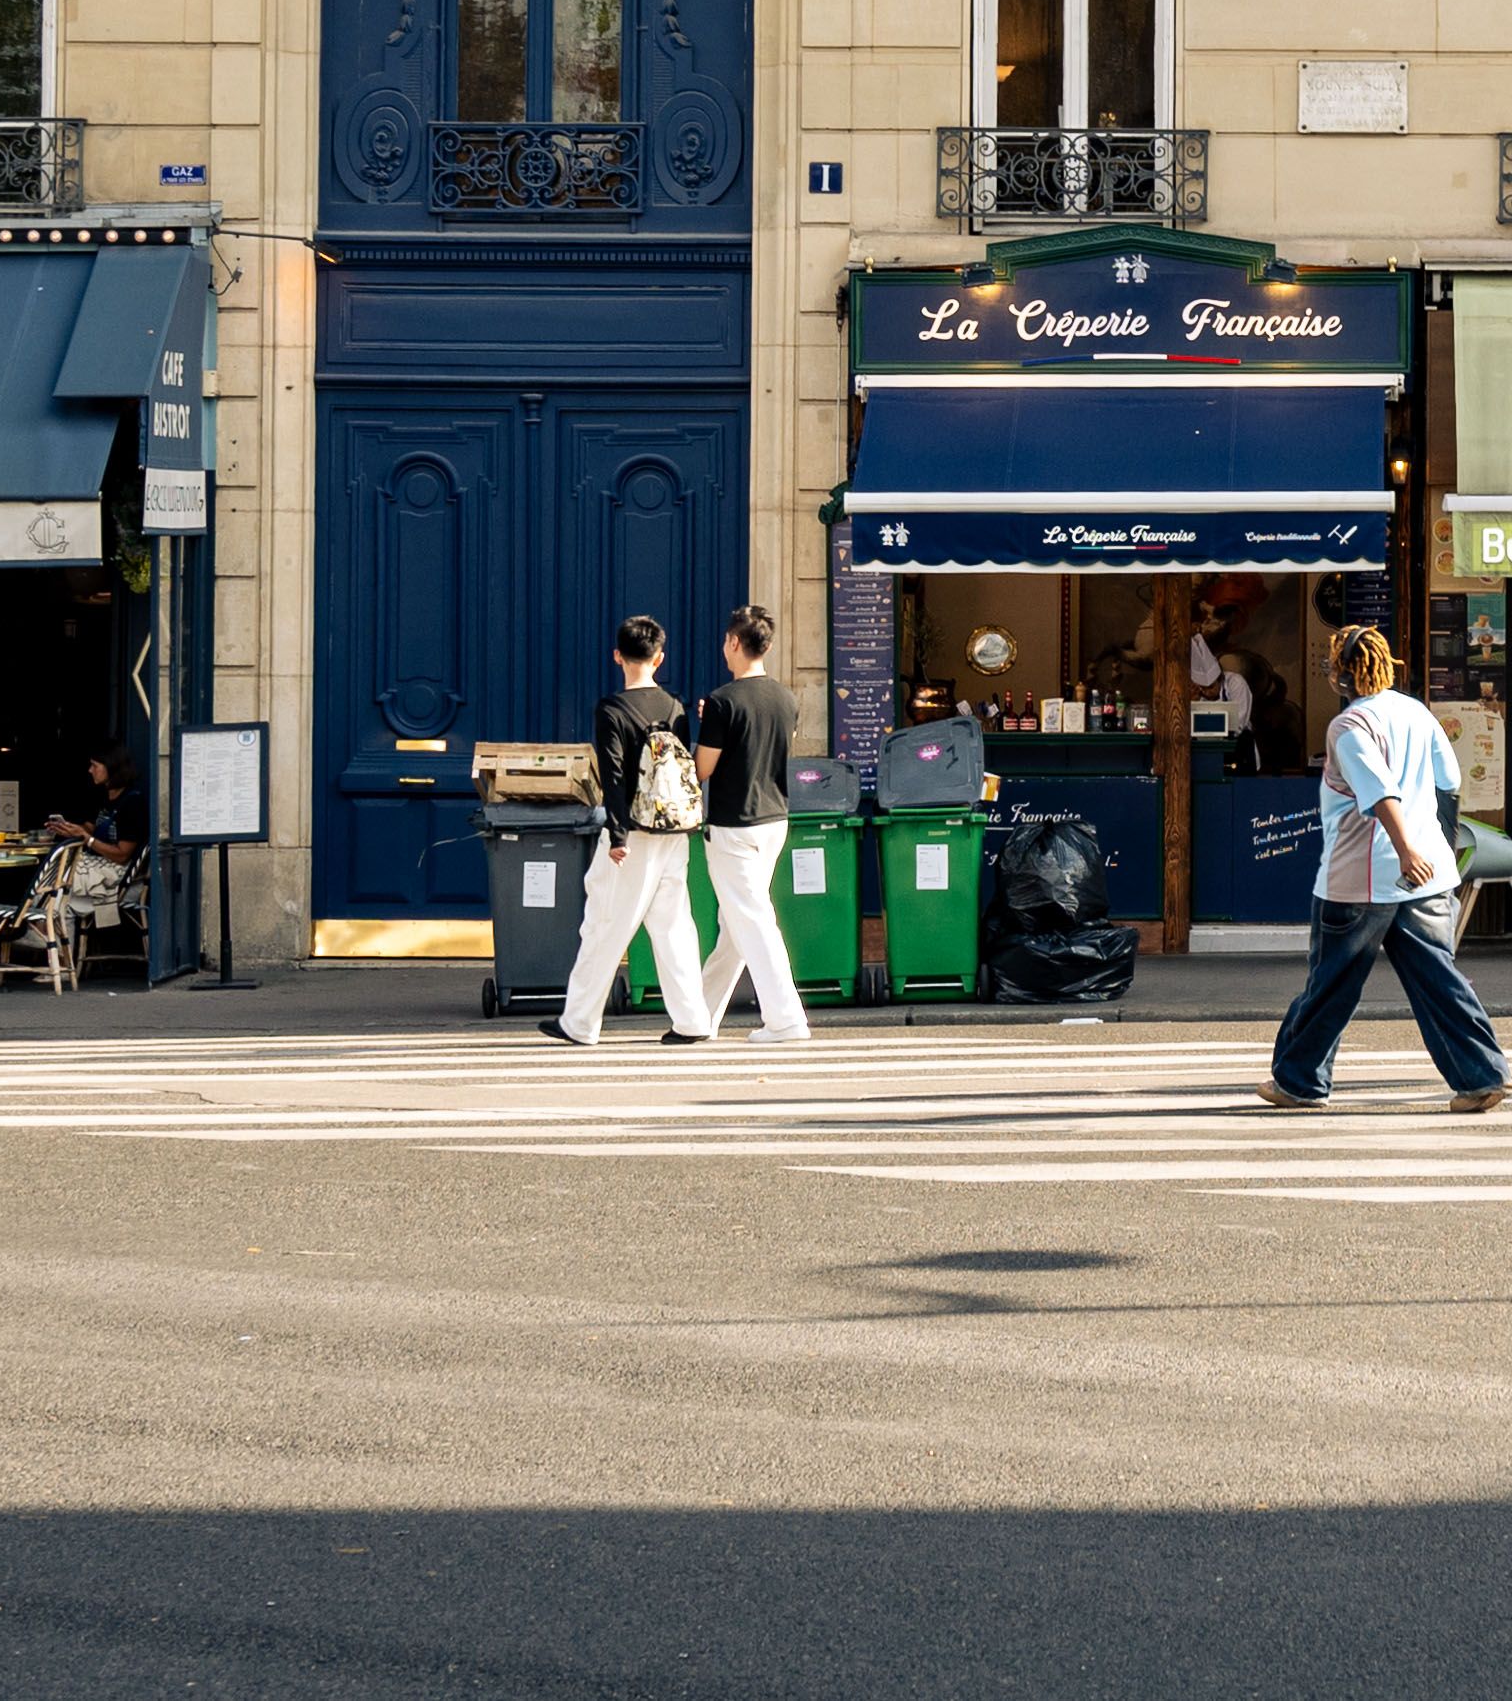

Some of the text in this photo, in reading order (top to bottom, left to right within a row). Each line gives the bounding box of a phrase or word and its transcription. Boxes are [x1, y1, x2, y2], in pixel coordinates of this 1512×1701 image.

[172, 166, 193, 176] GAZ
[919, 297, 1343, 347] La Crêperie Française
[153, 402, 191, 440] BISTROT
[1042, 524, 1196, 547] La Crêperie Française
